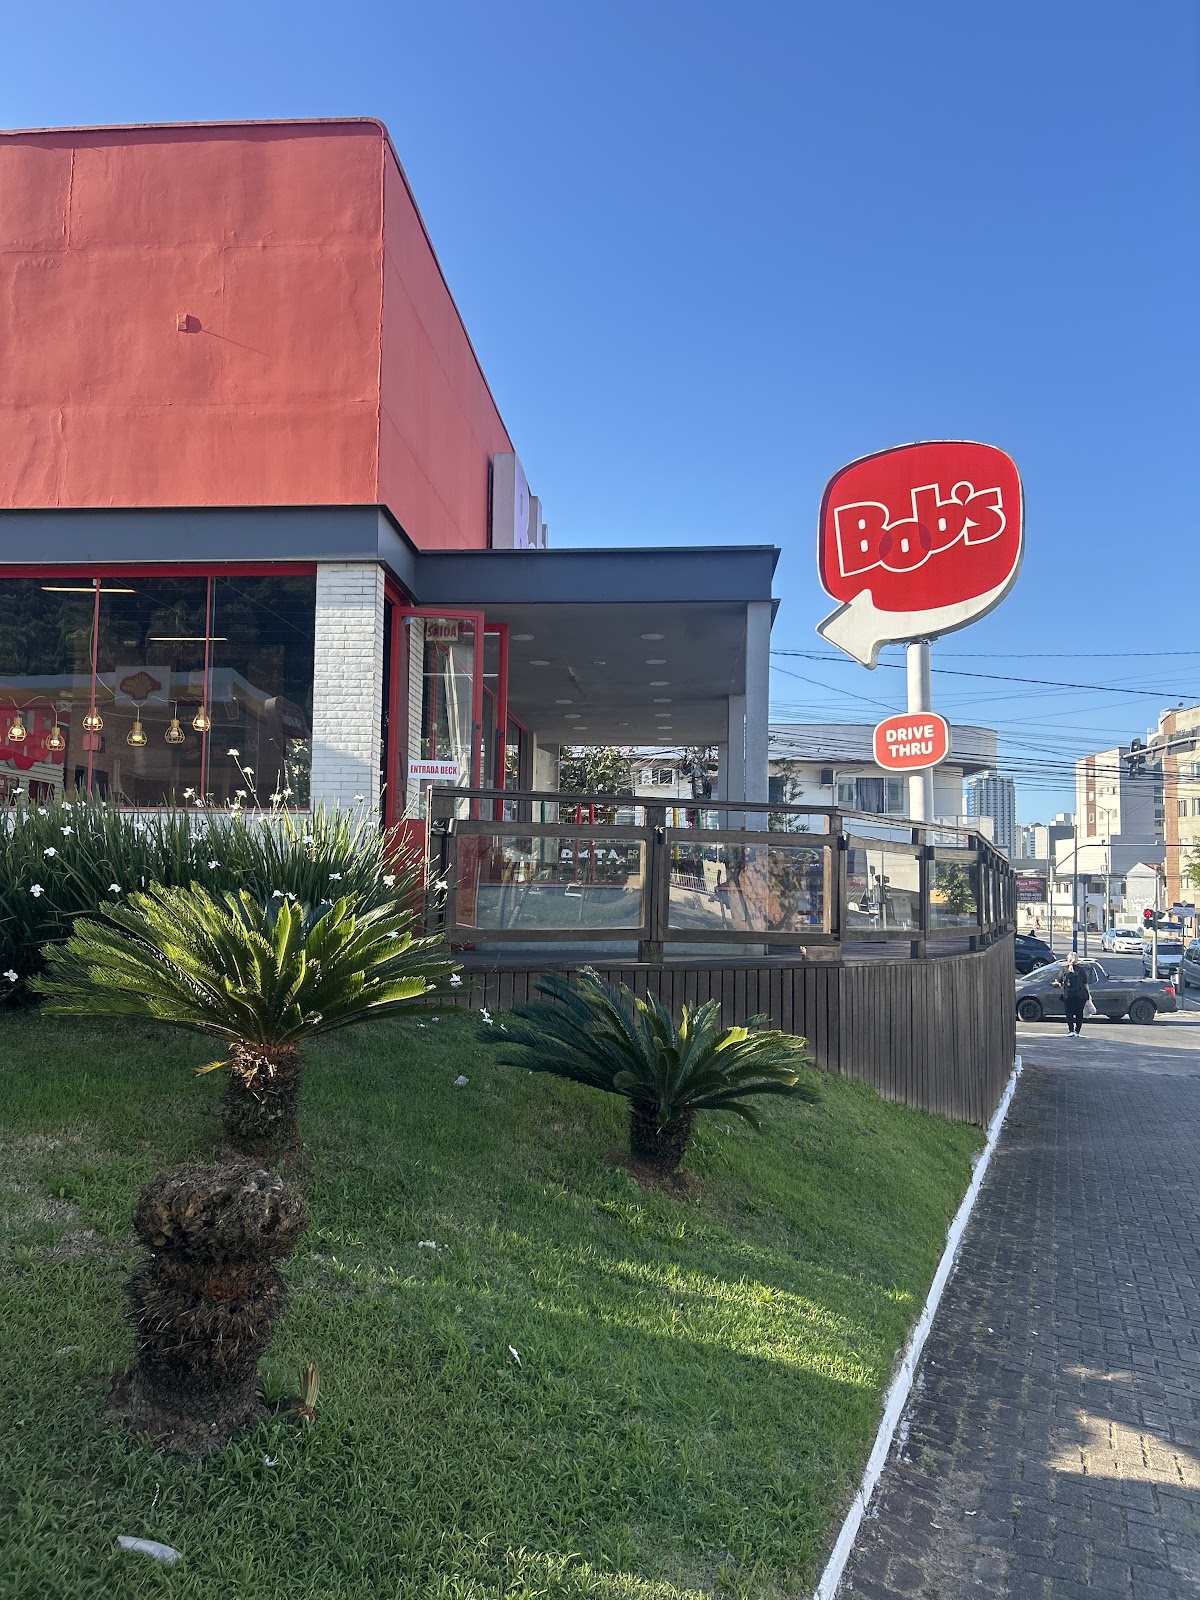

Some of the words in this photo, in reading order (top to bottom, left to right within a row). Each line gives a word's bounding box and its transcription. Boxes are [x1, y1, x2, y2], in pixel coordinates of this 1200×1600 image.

[833, 480, 1007, 578] Bob's
[885, 724, 935, 743] DRIVE
[888, 740, 933, 758] THRU
[410, 765, 440, 775] ENTRADA
[440, 766, 458, 775] DECK
